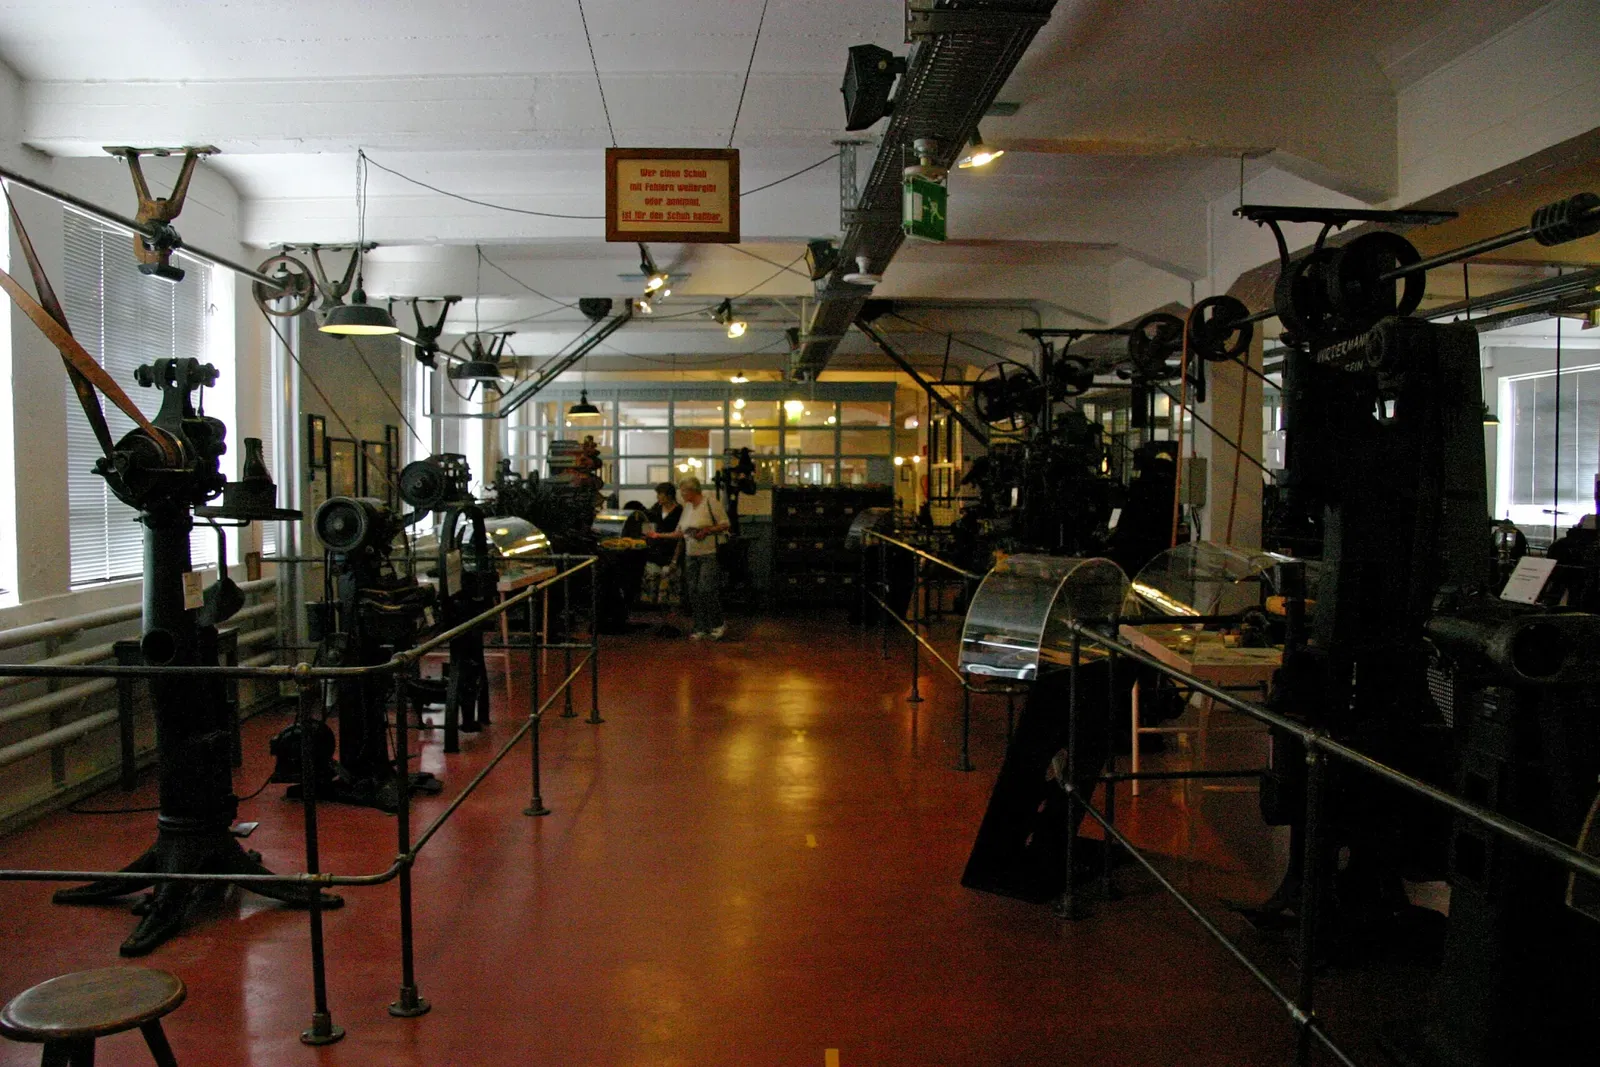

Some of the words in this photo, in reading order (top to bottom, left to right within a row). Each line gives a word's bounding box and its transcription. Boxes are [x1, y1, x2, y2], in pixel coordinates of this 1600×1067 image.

[640, 168, 657, 177] Wer
[660, 169, 681, 178] einen
[684, 169, 707, 178] Schuh
[629, 183, 642, 191] mit
[645, 183, 674, 192] Fehlern
[677, 183, 717, 193] weitergibt
[644, 197, 663, 206] oder
[622, 210, 632, 219] ist
[634, 210, 647, 219] für
[649, 211, 664, 220] den
[667, 211, 690, 220] Schuh
